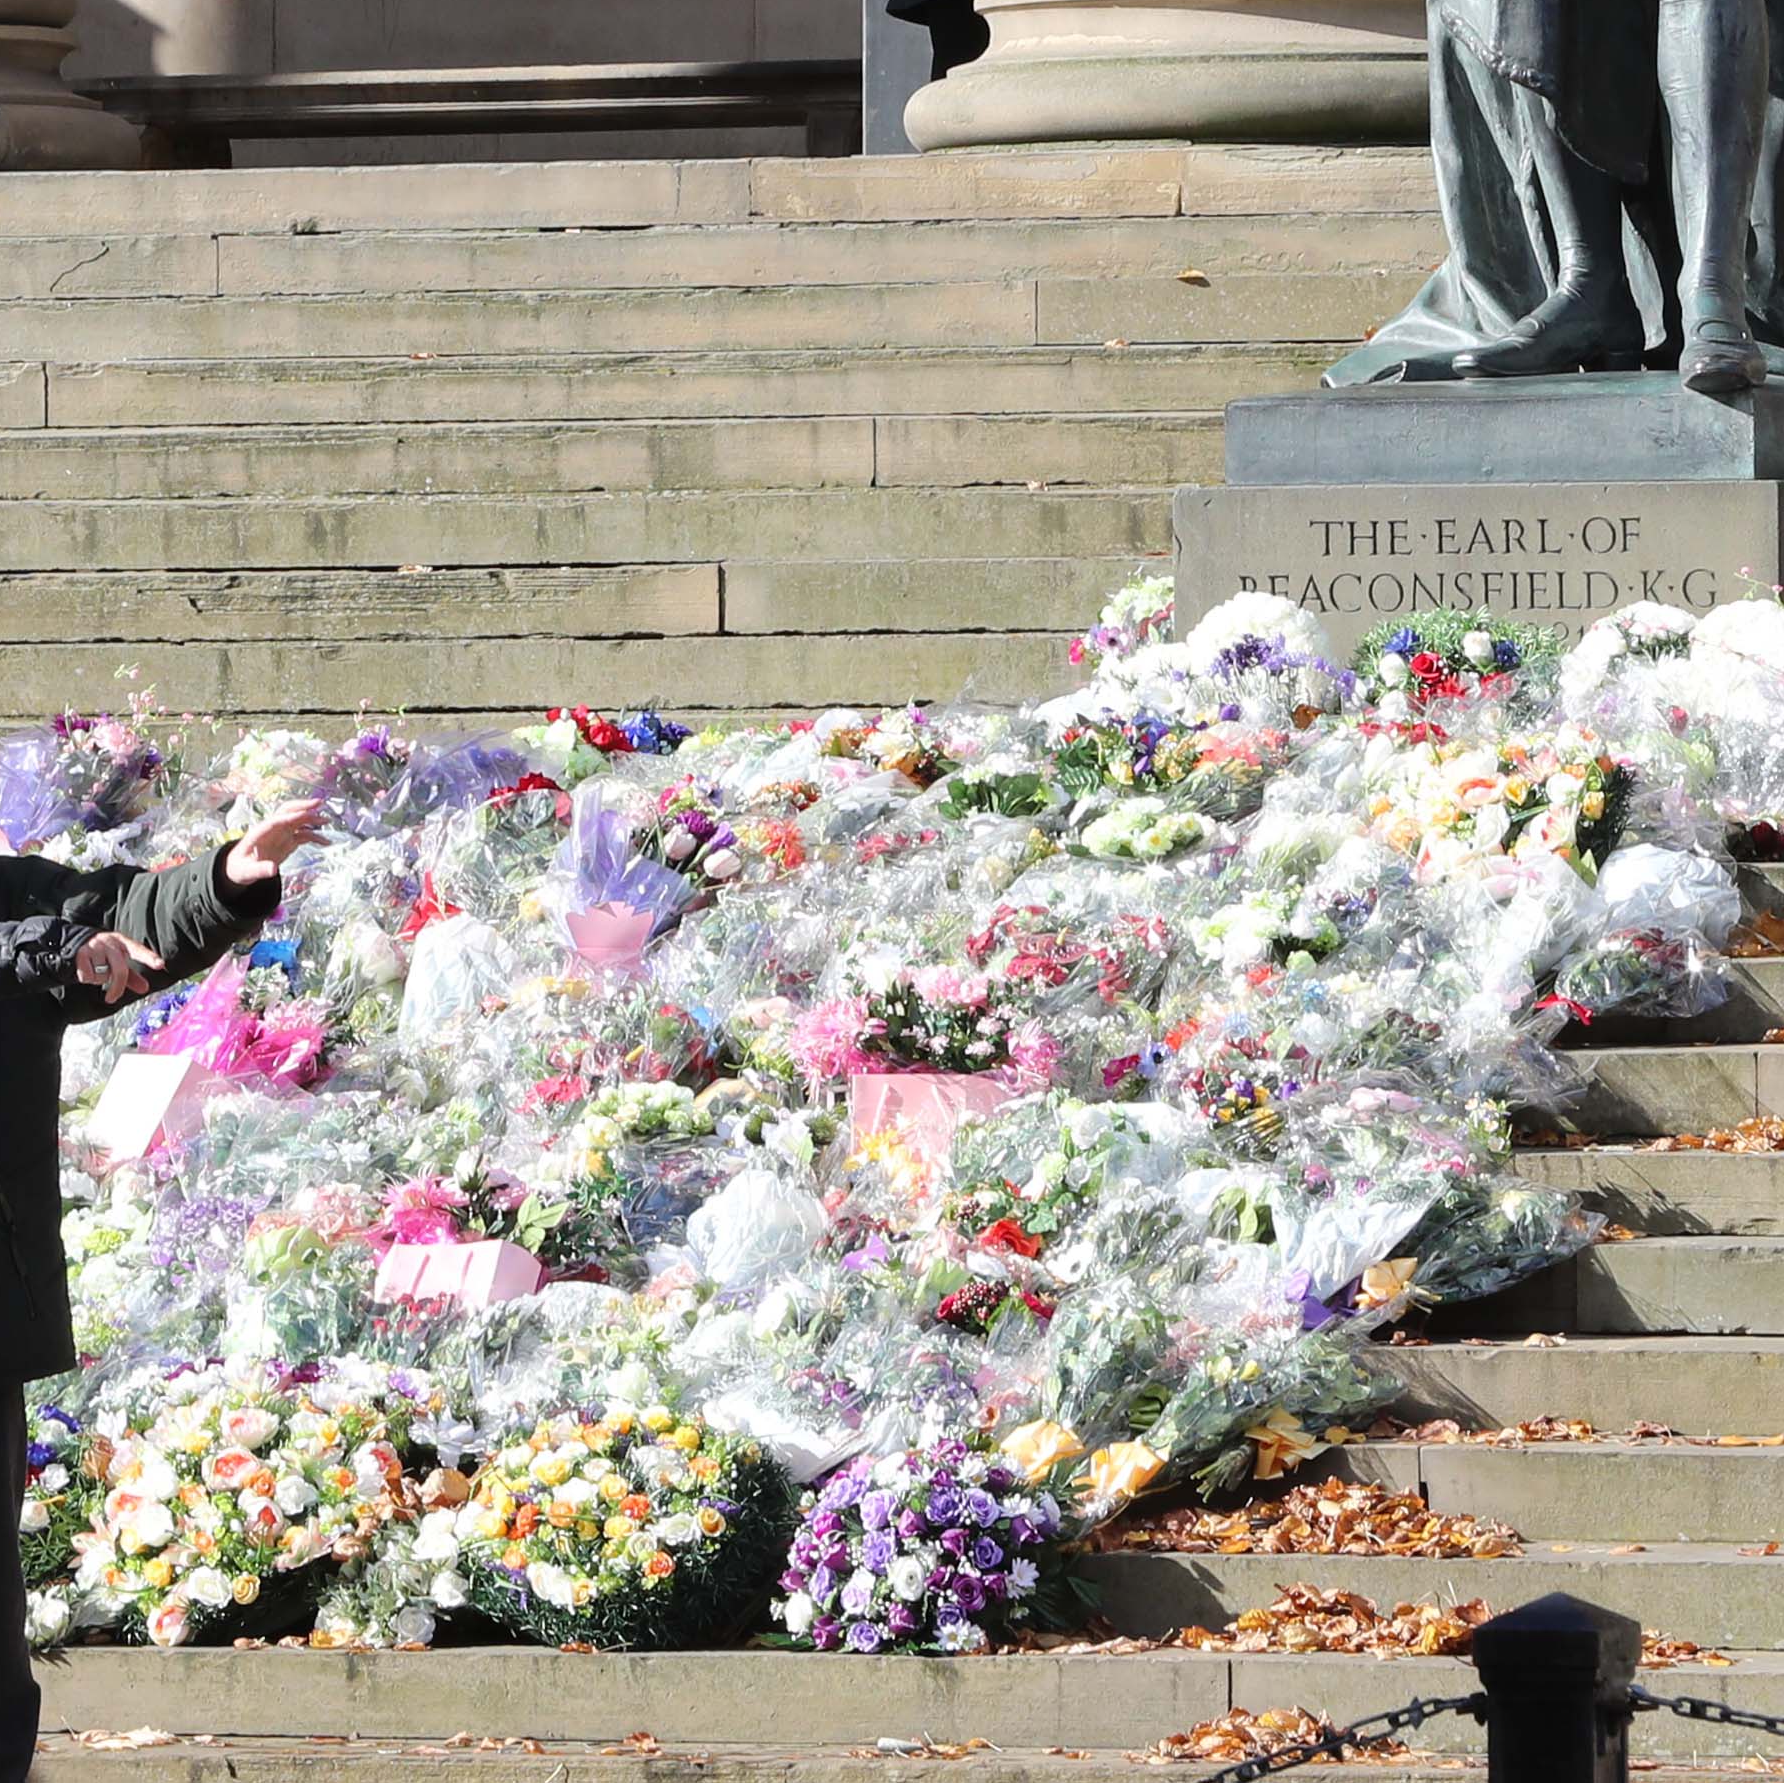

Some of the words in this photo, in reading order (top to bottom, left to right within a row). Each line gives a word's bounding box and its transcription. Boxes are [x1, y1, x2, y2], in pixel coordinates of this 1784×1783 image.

[1309, 518, 1413, 556] THE
[1434, 517, 1563, 555] EARL
[1581, 516, 1641, 554] OF
